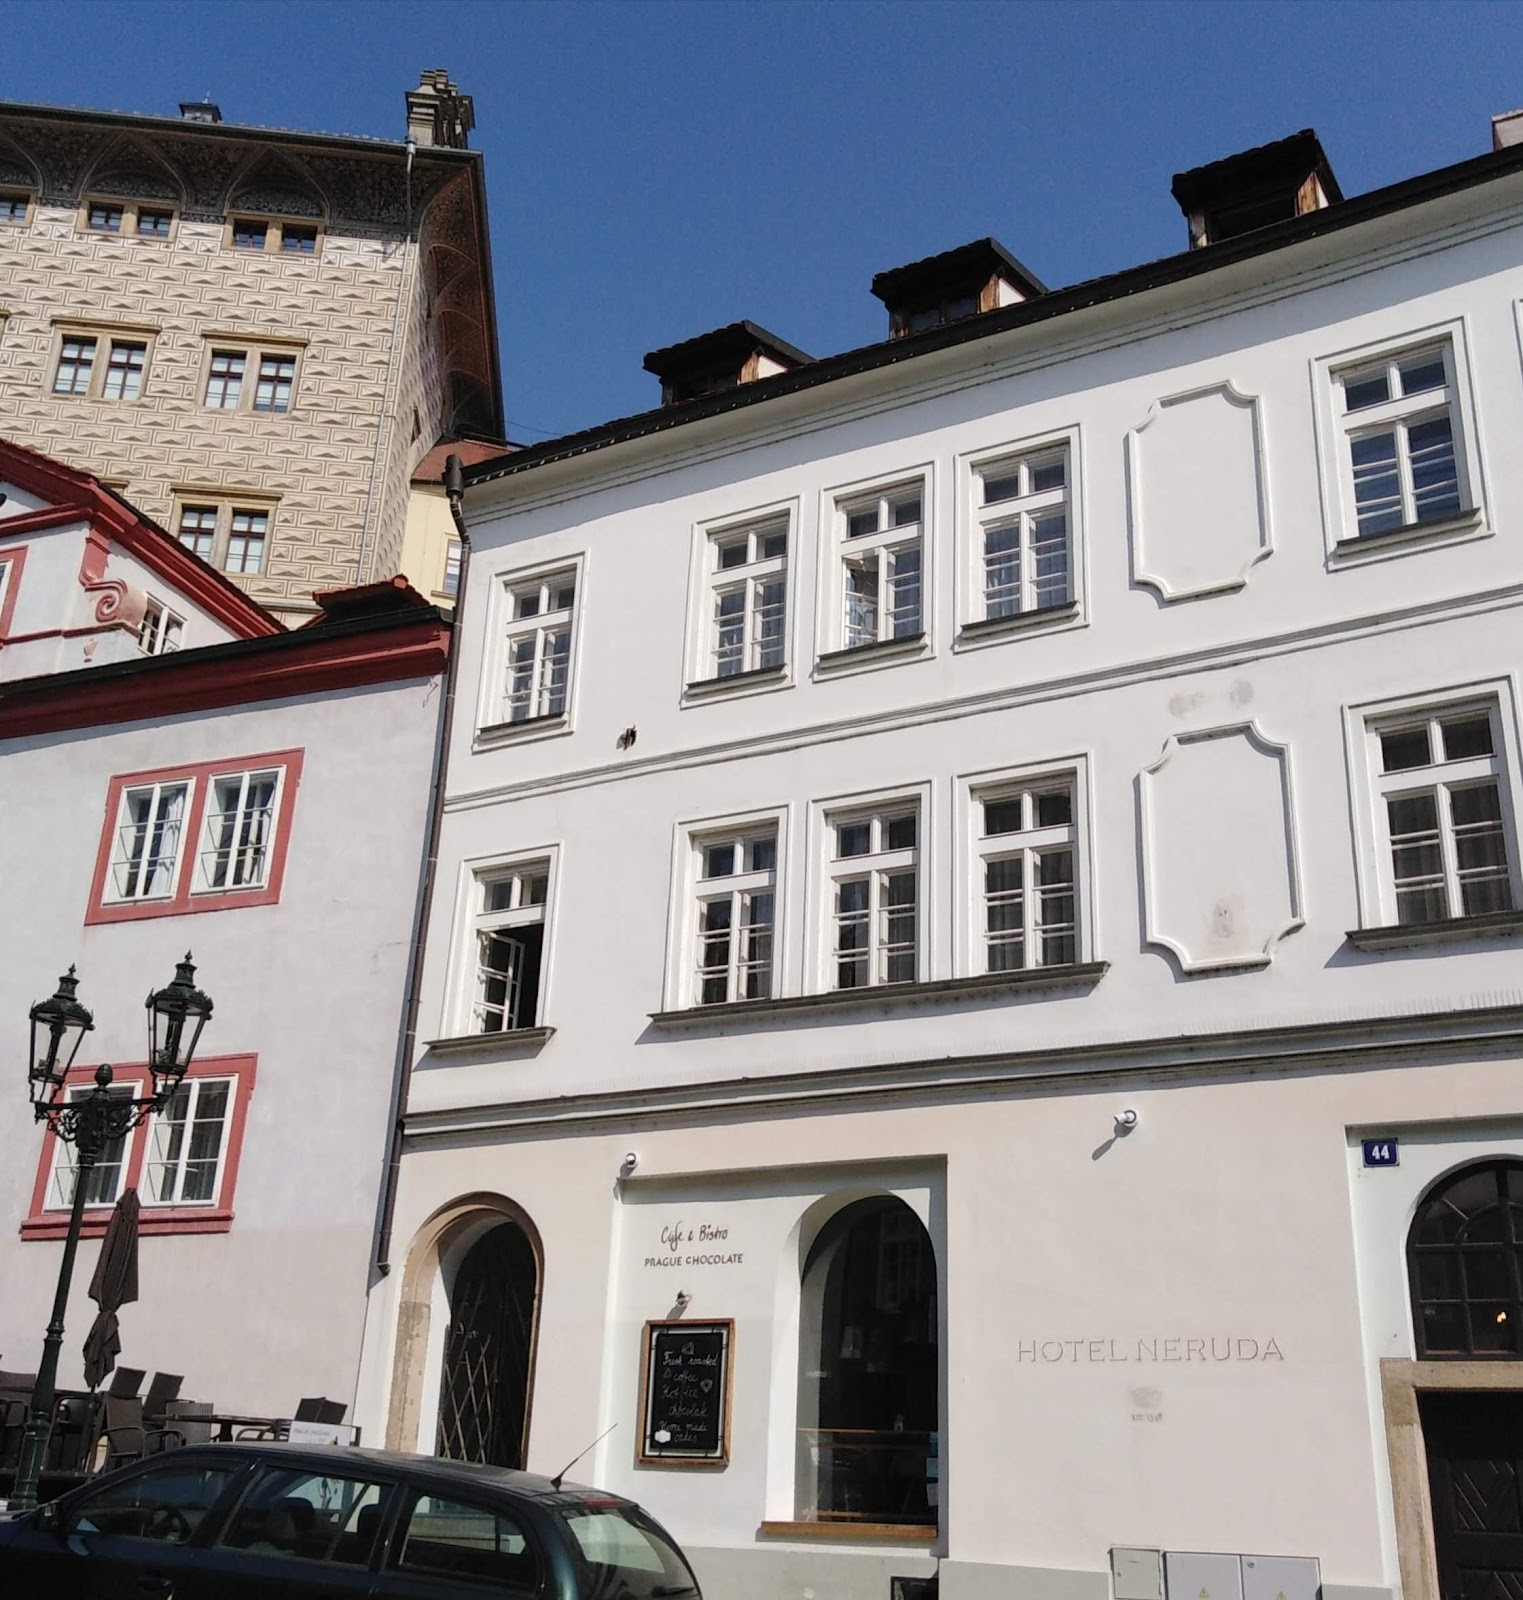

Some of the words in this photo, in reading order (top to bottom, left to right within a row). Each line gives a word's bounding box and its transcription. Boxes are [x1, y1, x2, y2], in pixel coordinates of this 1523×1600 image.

[1371, 1144, 1390, 1160] 44
[698, 1224, 728, 1242] Bistro
[644, 1256, 683, 1267] PRAGUE
[685, 1253, 744, 1265] CHOCOLATE
[1018, 1339, 1128, 1363] HOTEL
[1135, 1336, 1285, 1362] NERUDA
